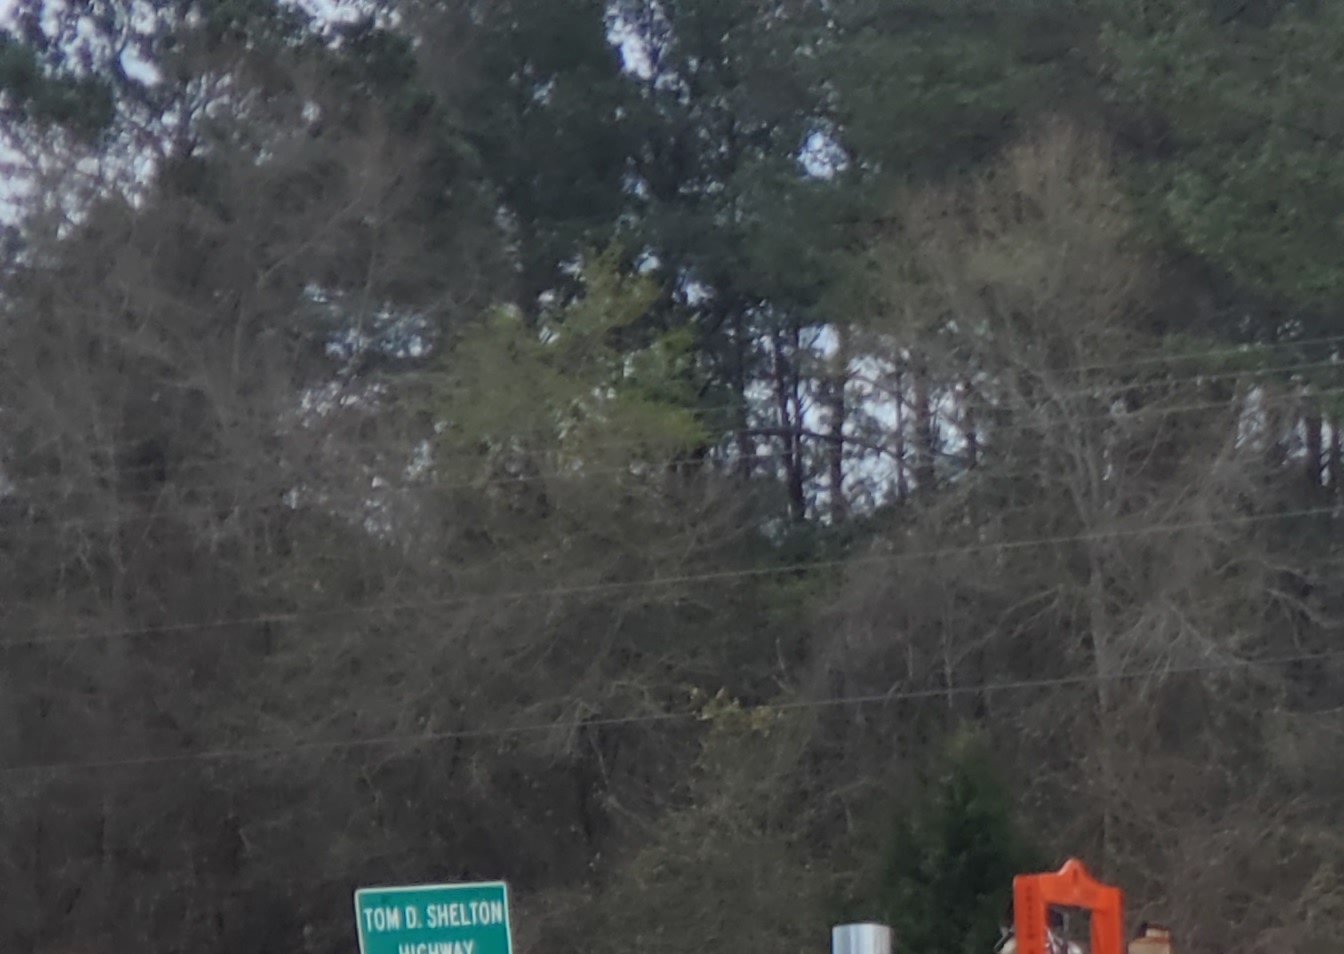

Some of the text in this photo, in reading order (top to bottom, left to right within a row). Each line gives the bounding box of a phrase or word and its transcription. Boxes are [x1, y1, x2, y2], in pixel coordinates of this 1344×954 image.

[364, 901, 502, 932] TOM D. SHELTON
